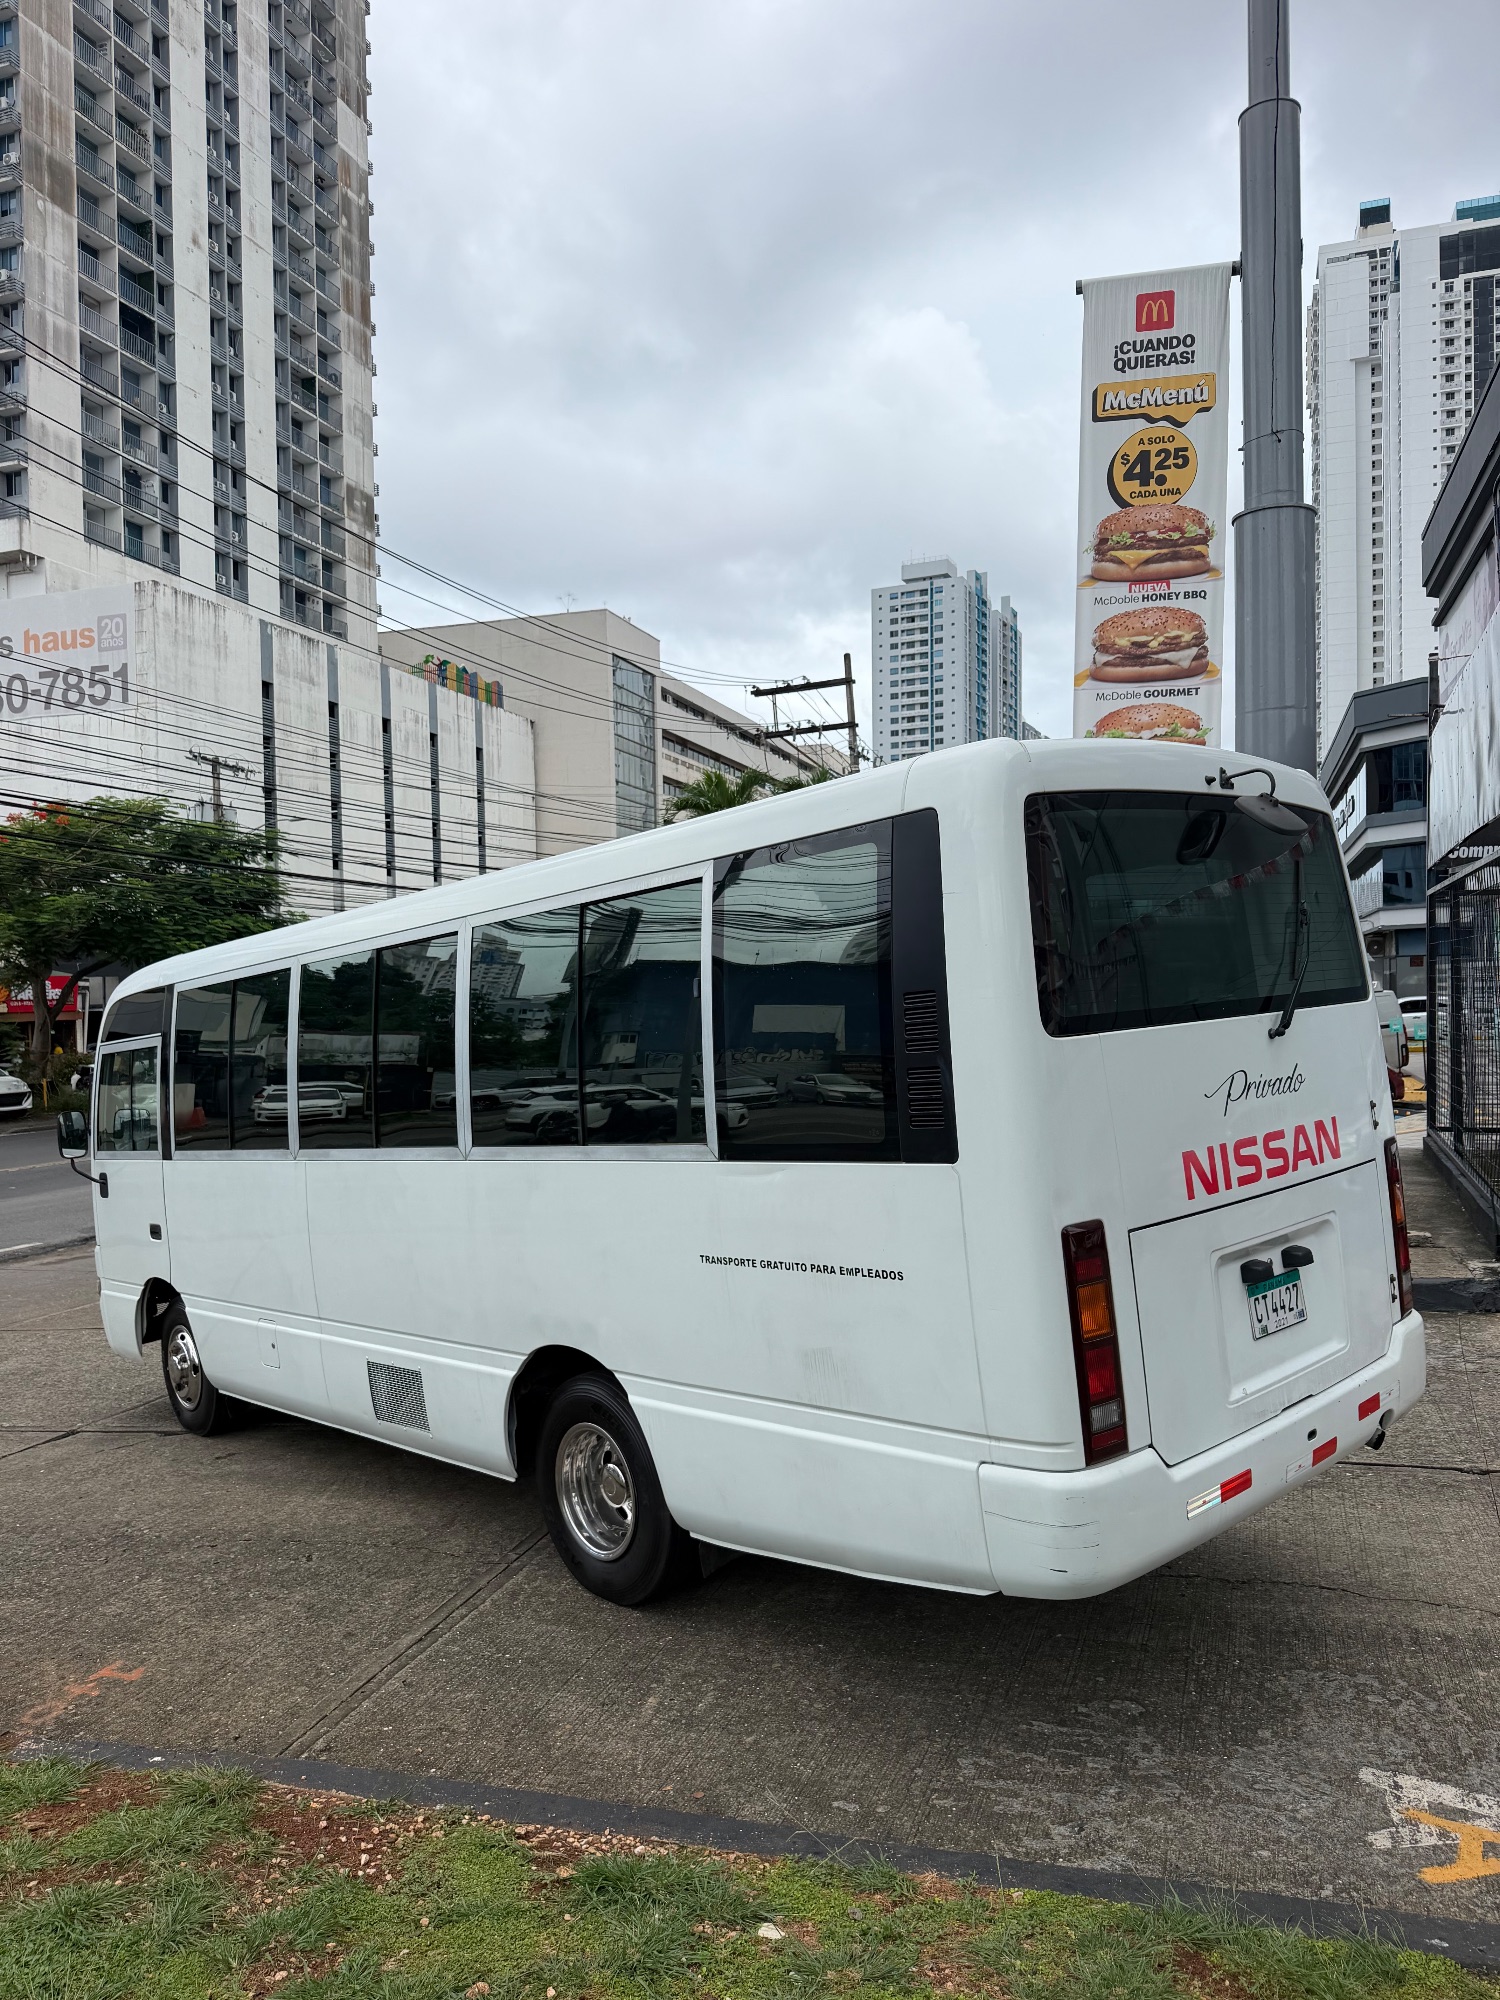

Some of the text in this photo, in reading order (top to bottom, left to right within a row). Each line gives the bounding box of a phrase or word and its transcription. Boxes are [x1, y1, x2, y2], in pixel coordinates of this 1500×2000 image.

[1113, 333, 1196, 358] ¡CUANDO
[1113, 350, 1196, 374] QUIERAS!
[1102, 378, 1210, 413] McMenú
[1137, 434, 1176, 446] A SOLO
[1129, 487, 1182, 500] CADA UNA
[1093, 589, 1208, 606] McDoble HONEY BBQ
[1131, 582, 1169, 593] NUEVA
[100, 616, 124, 640] 20
[23, 626, 96, 655] haus
[100, 634, 124, 649] años
[0, 662, 129, 714] 0-7851
[1095, 686, 1201, 702] McDoble GOURMET
[1204, 1063, 1306, 1117] Privado
[1181, 1115, 1342, 1201] NISSAN
[699, 1254, 905, 1281] TRANSPORTE GRATUITO PARA EMPLEADOS
[1253, 1283, 1299, 1323] CT4427
